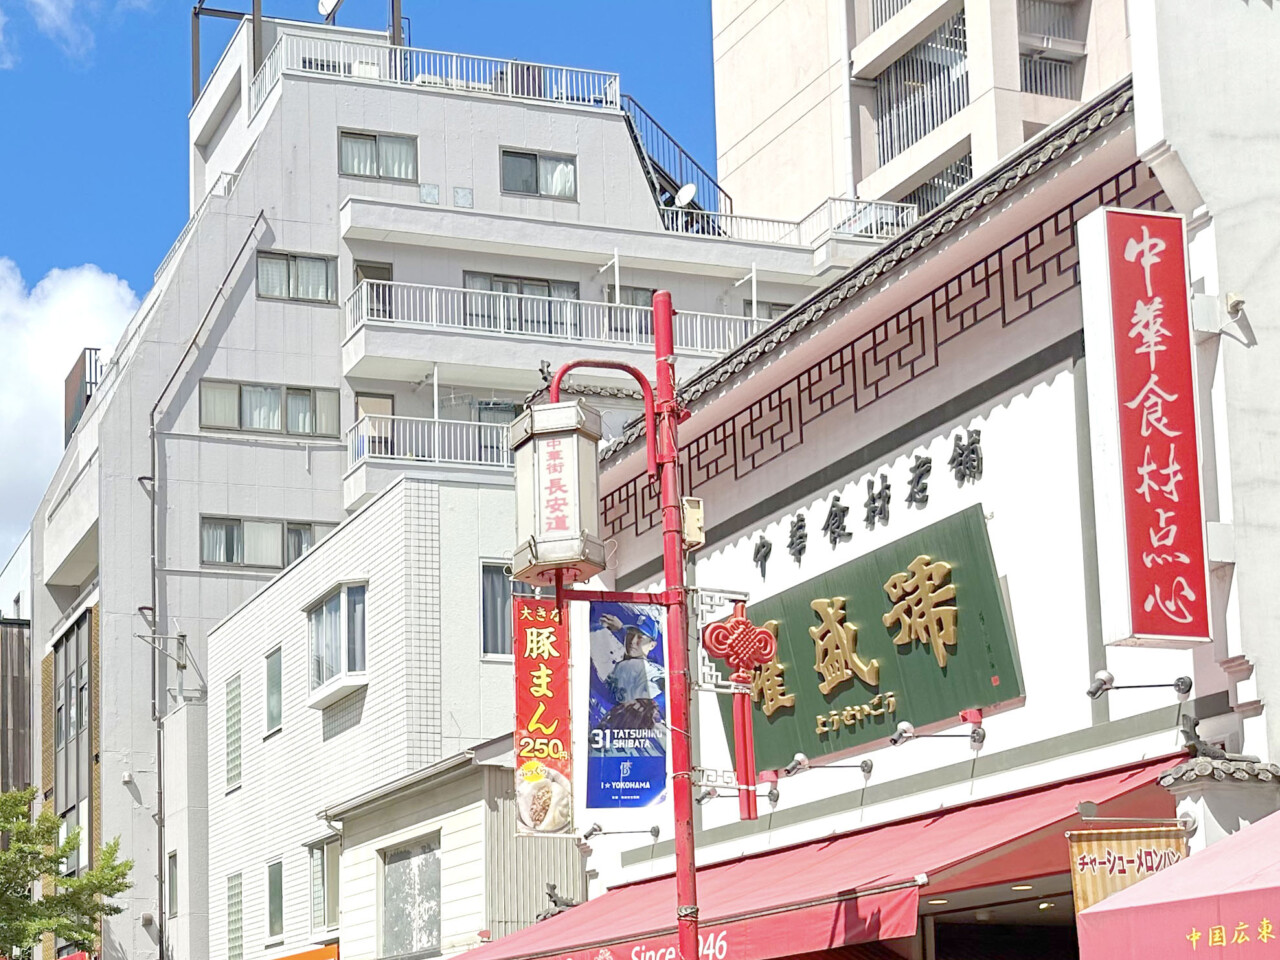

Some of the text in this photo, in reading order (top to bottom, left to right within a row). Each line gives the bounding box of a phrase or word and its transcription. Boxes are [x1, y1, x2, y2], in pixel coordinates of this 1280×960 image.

[1123, 226, 1196, 624] 中華食材点心
[523, 626, 561, 735] 豚まん
[591, 729, 611, 748] 31
[613, 739, 650, 748] SHIBATA
[1186, 918, 1276, 951] 中国広東
